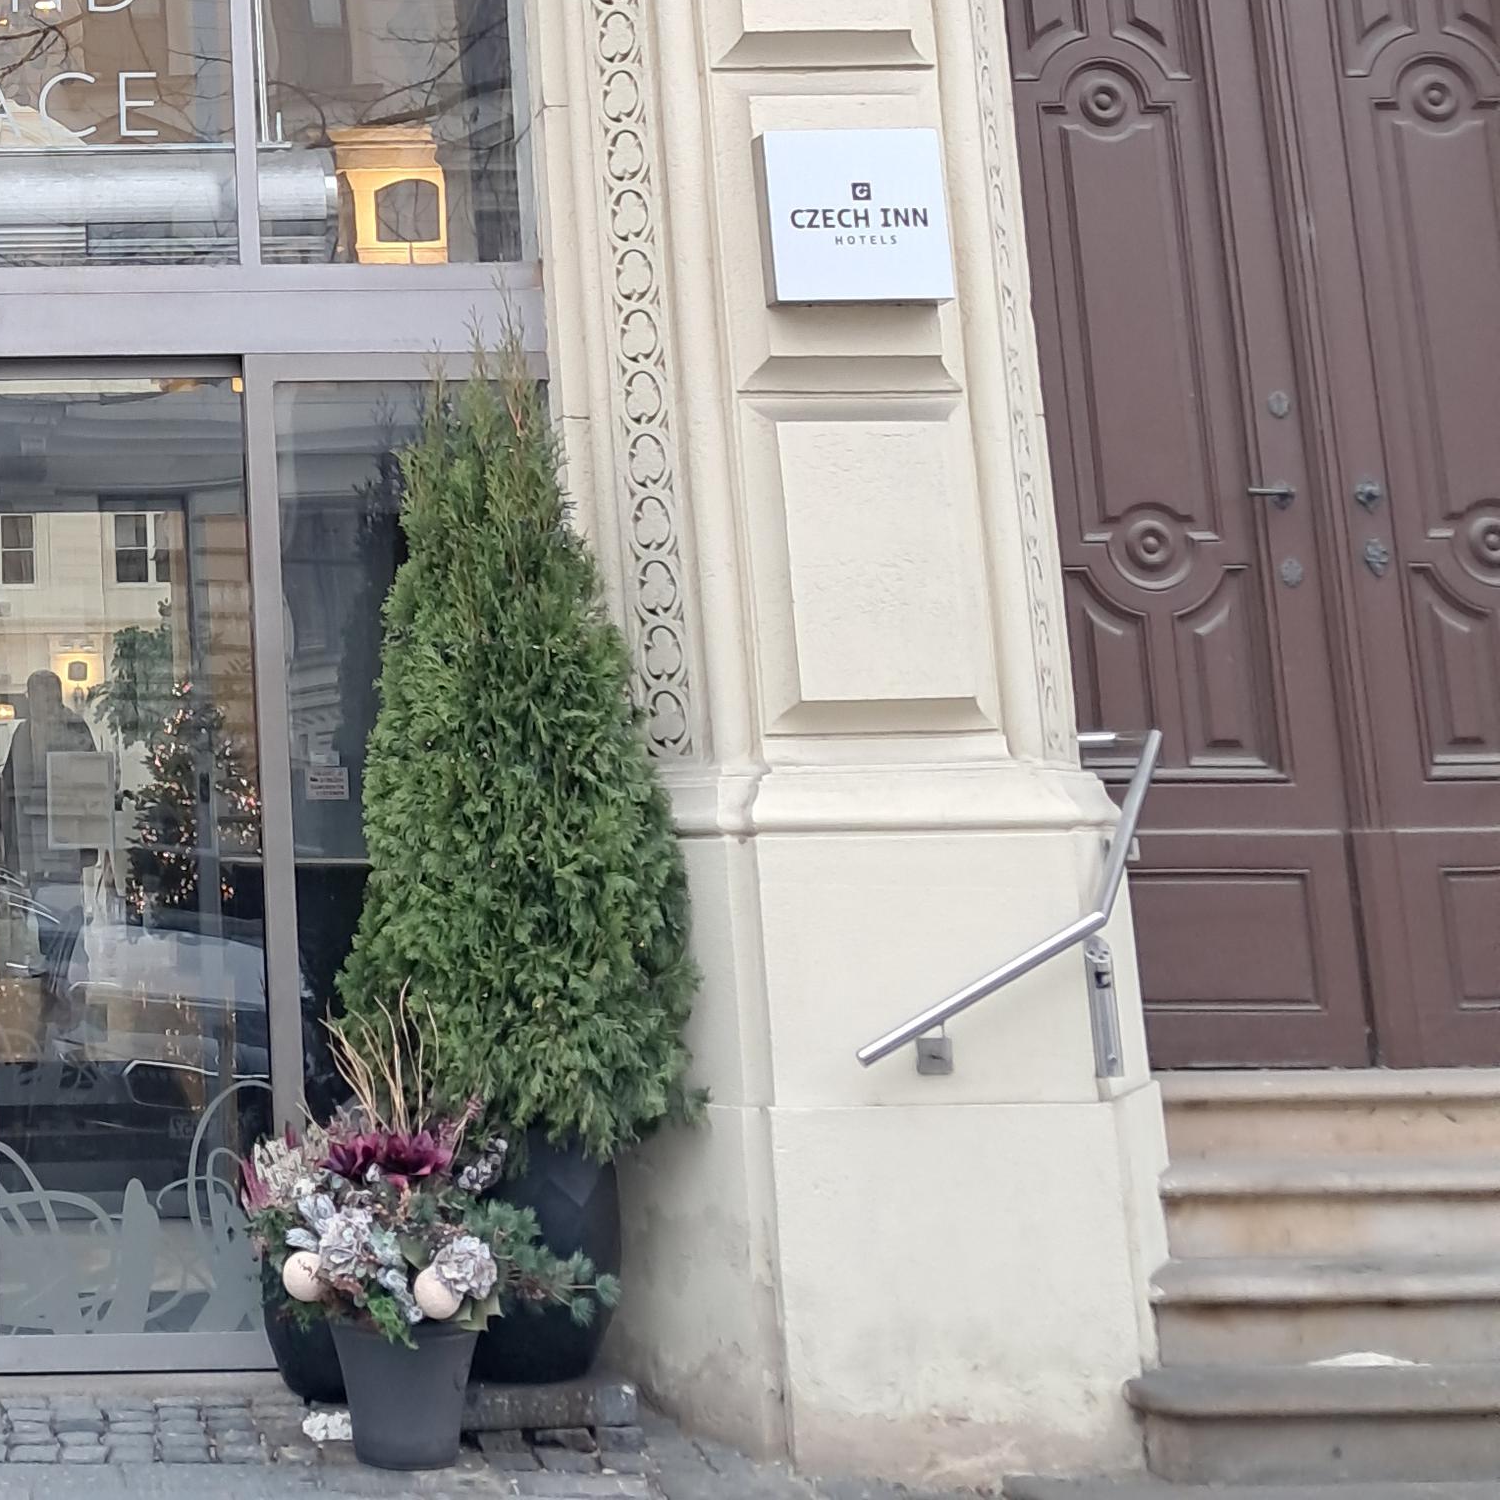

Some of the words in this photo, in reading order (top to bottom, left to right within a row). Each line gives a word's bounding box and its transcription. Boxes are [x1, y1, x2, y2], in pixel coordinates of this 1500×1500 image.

[790, 208, 871, 229] CZECH
[880, 207, 929, 228] INN
[835, 234, 898, 245] HOTELS
